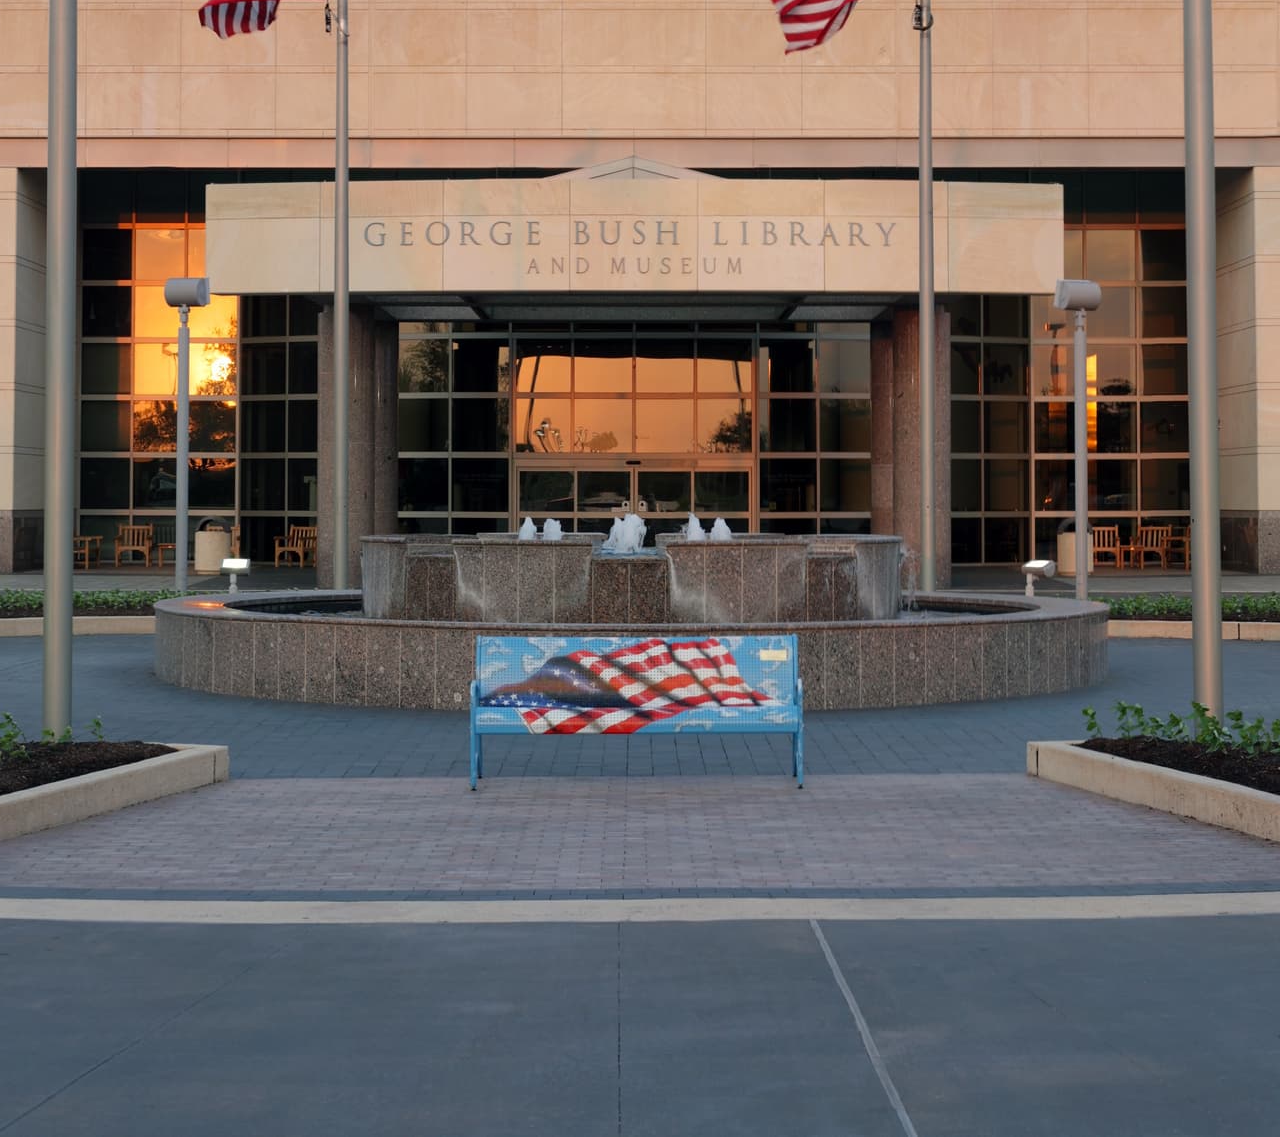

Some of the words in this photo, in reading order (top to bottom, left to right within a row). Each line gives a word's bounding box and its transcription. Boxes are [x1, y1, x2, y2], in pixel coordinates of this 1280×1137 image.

[363, 221, 542, 247] GEORGE
[573, 220, 680, 246] BUSH
[713, 221, 897, 247] LIBRARY
[526, 256, 591, 275] AND
[609, 256, 742, 275] MUSEUM
